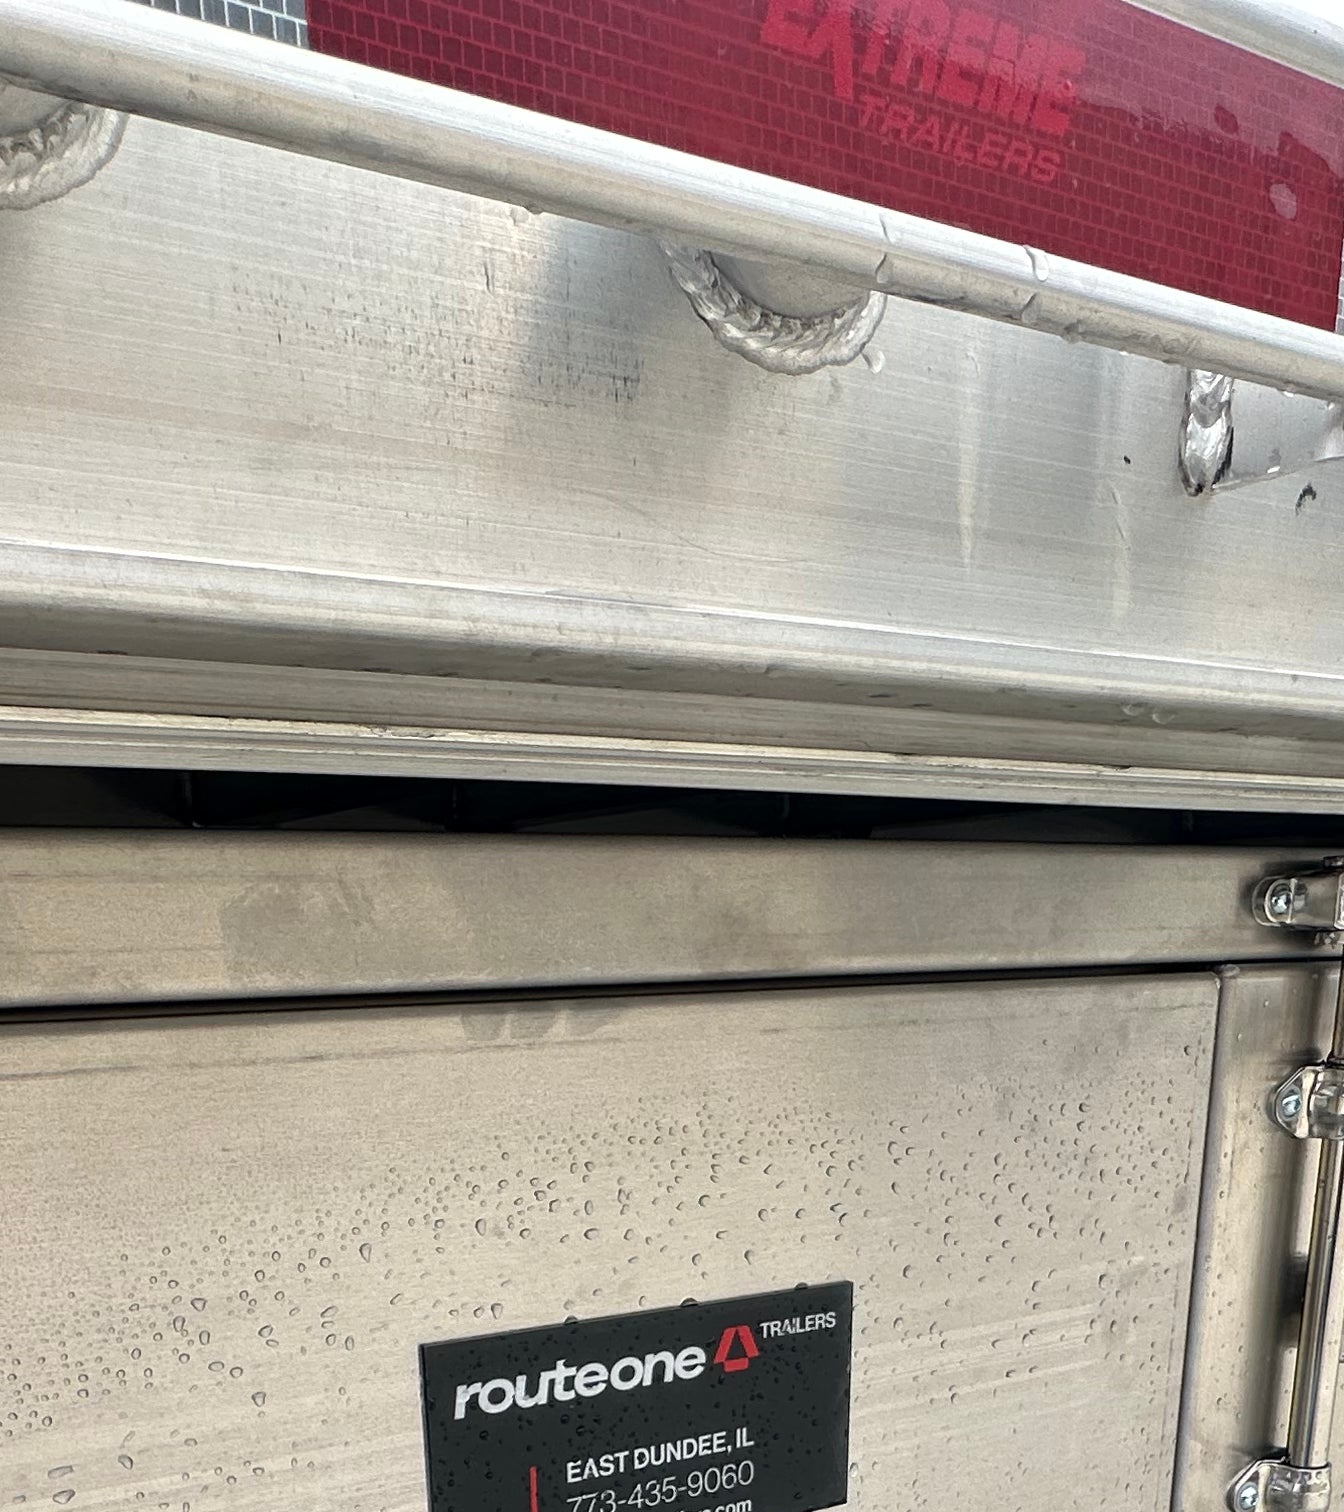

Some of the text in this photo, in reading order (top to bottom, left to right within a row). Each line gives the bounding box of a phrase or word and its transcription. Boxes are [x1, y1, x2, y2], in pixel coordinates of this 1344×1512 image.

[857, 92, 1061, 184] TRAILERS
[454, 1311, 837, 1421] routeone TRAILERS
[566, 1427, 756, 1484] EAST DUNDEE, IL
